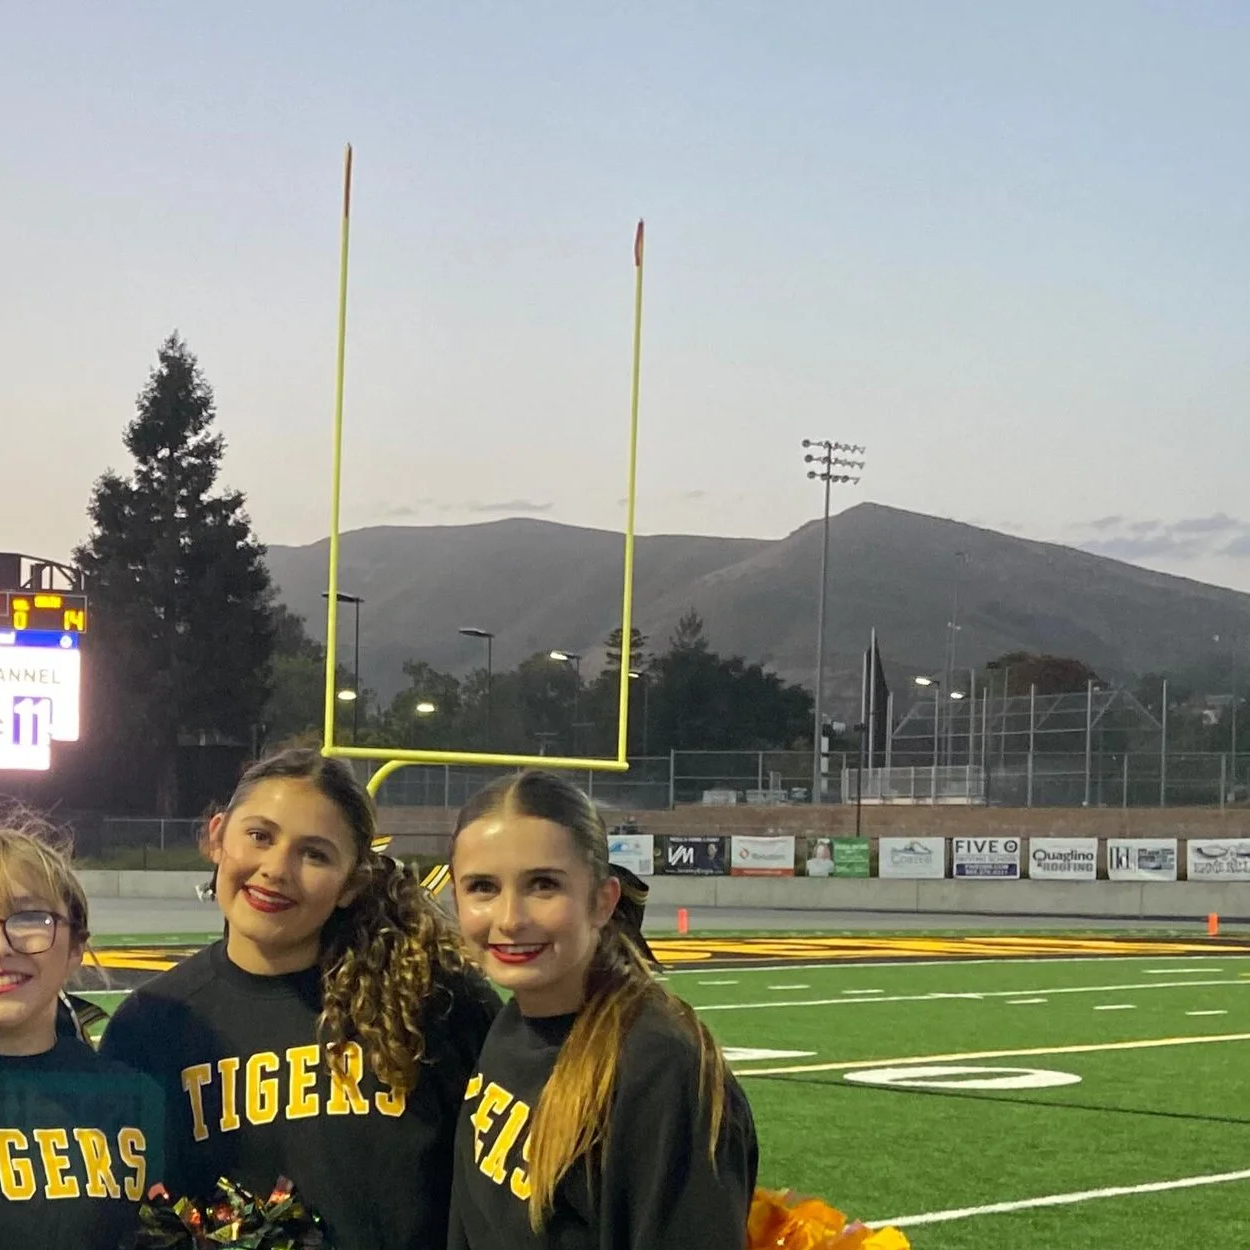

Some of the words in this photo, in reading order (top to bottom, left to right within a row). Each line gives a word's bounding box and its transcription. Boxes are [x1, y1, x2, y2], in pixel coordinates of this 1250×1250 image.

[63, 610, 84, 631] 14
[13, 697, 54, 745] 11
[955, 840, 999, 854] FIVE
[1032, 849, 1094, 862] Quaglino
[1041, 862, 1094, 872] ROOFING
